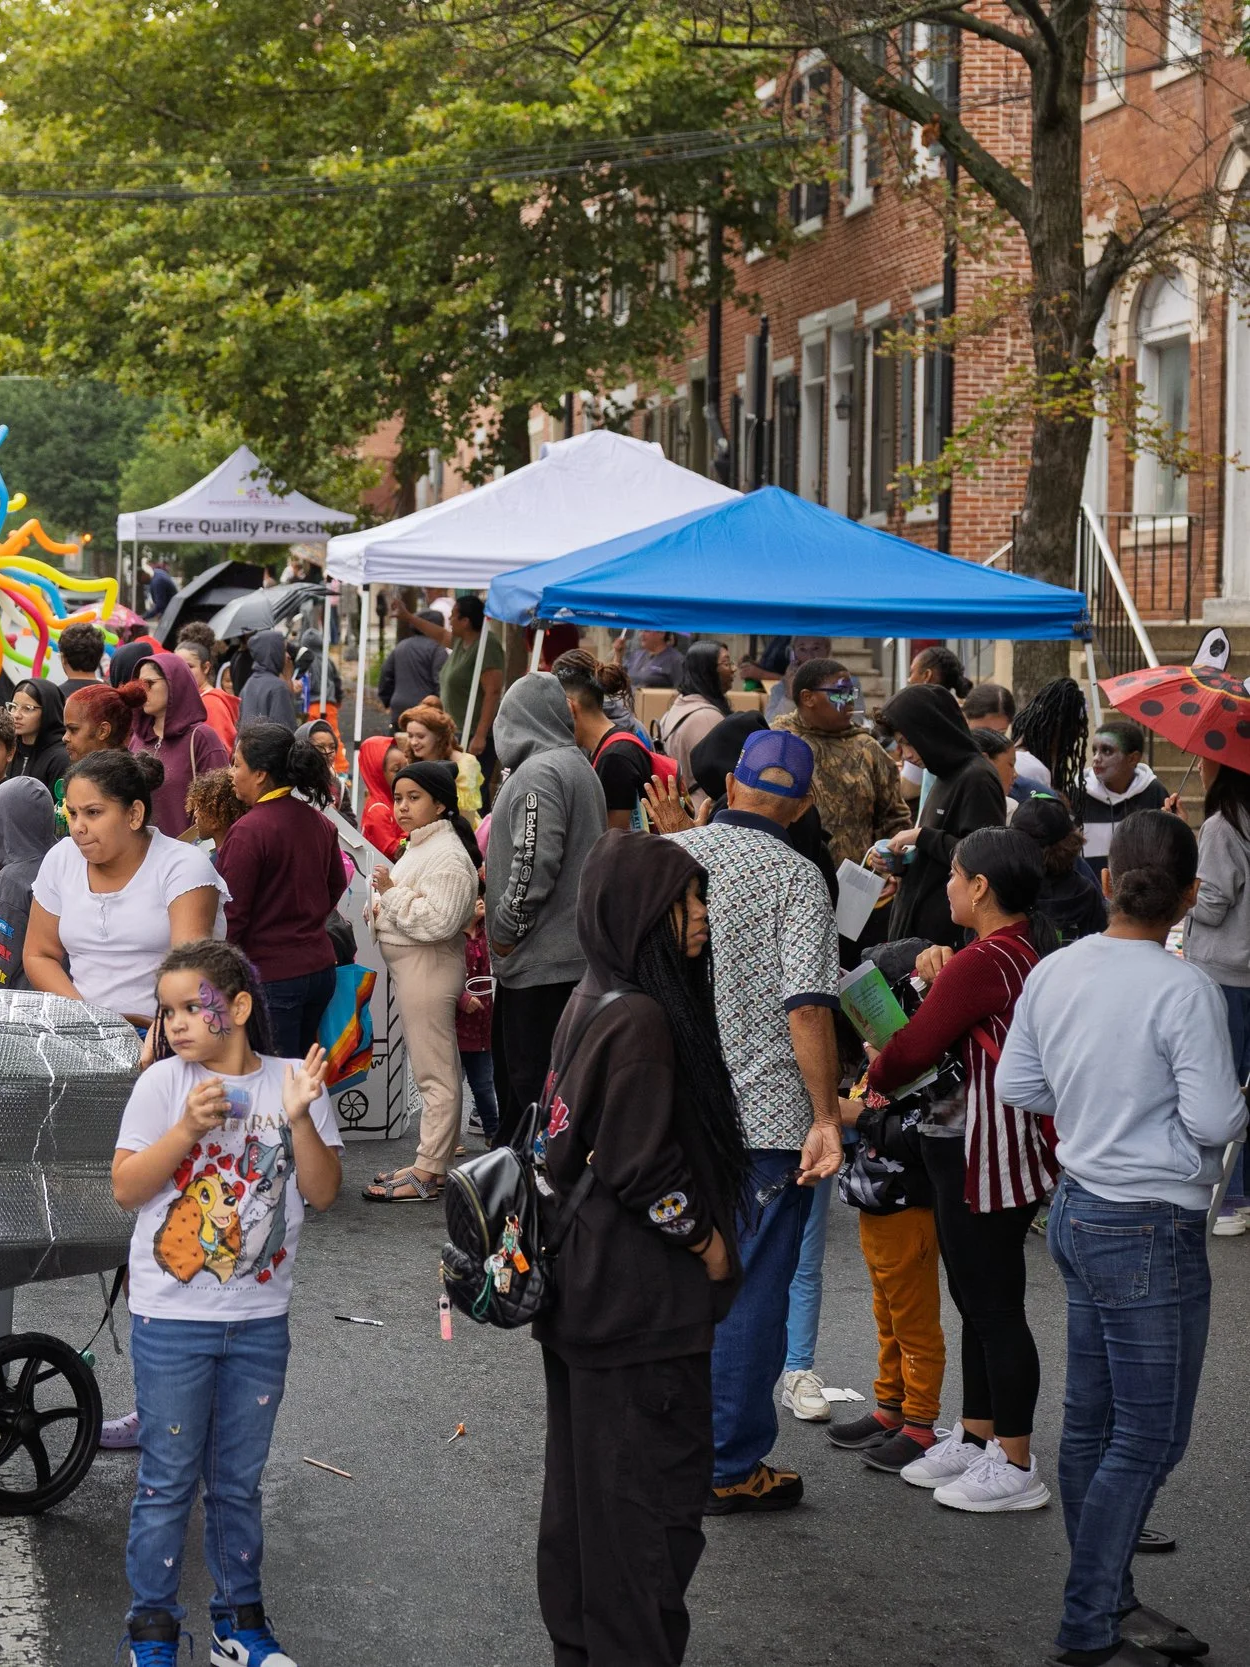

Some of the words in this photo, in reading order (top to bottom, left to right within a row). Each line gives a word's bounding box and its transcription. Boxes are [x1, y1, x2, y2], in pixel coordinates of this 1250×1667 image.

[158, 519, 193, 533] Free
[198, 519, 259, 537] Quality
[264, 519, 342, 534] Pre-Sch
